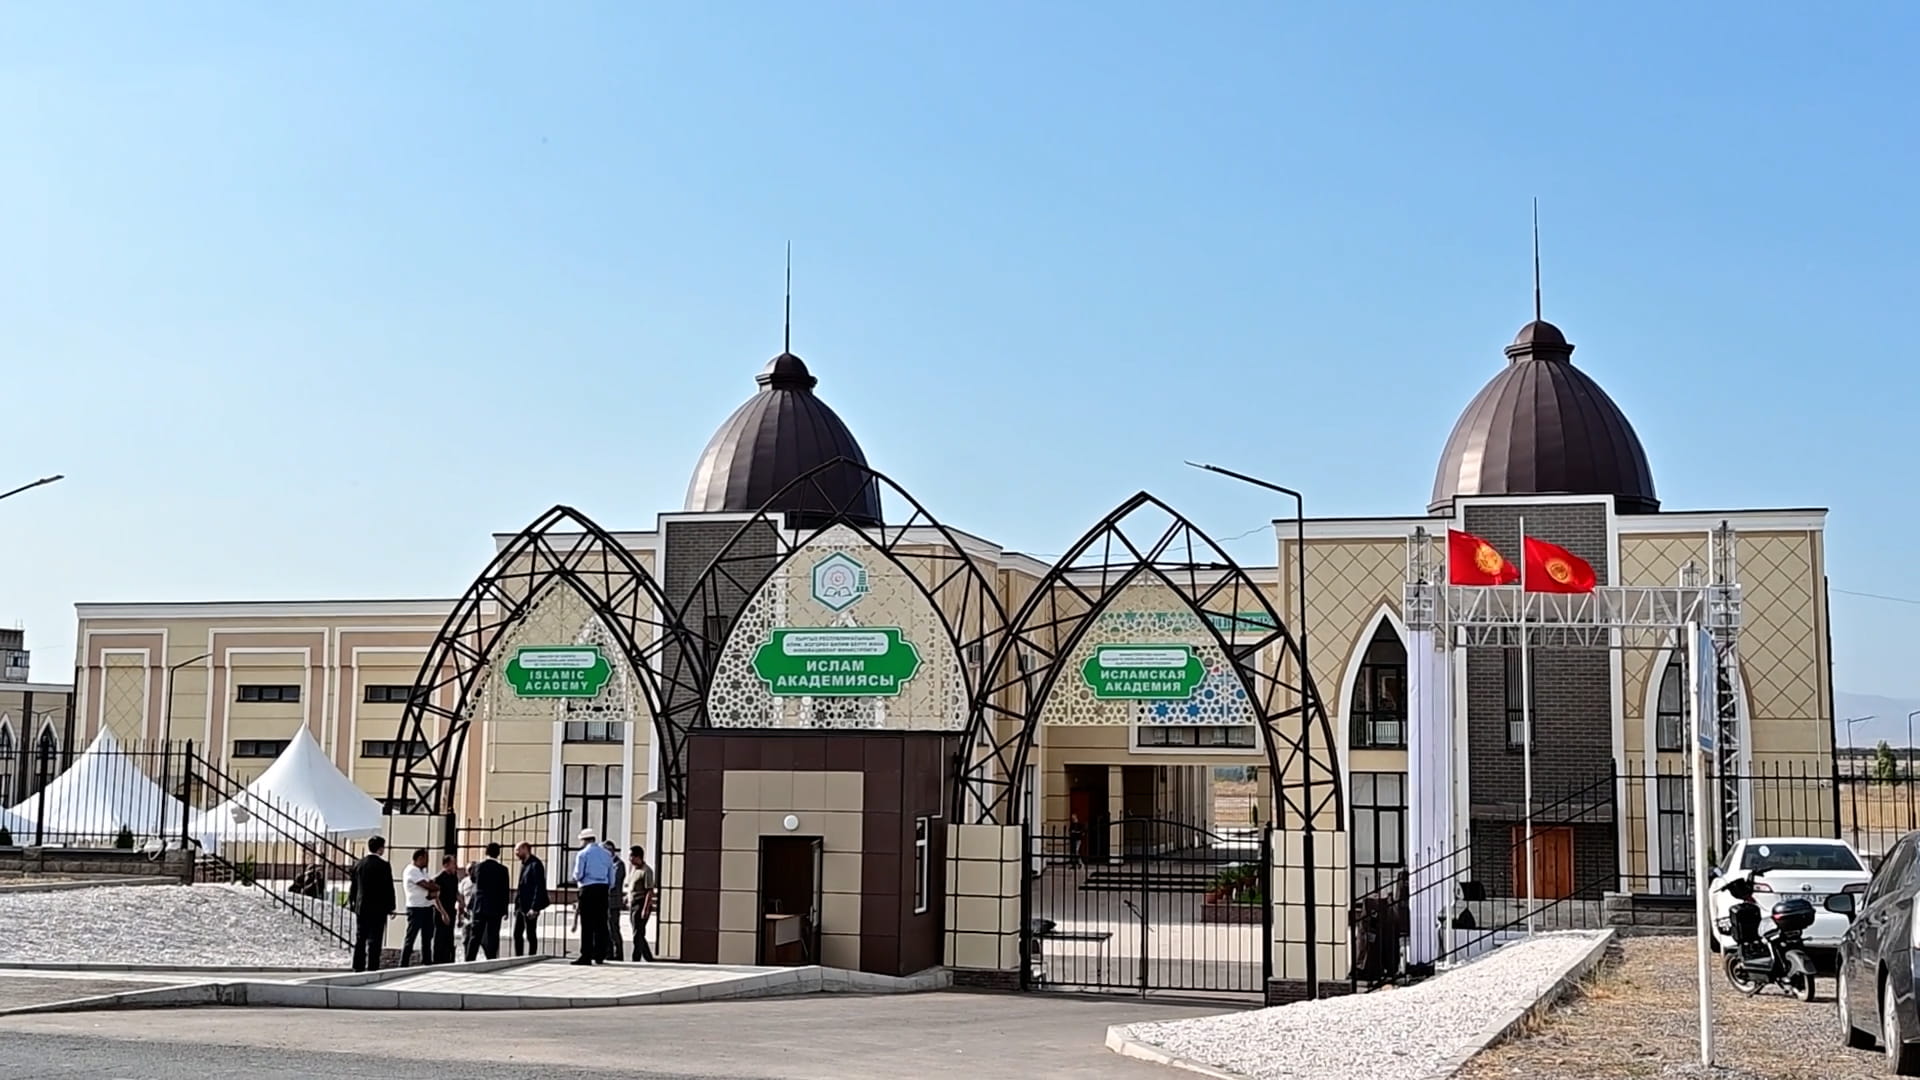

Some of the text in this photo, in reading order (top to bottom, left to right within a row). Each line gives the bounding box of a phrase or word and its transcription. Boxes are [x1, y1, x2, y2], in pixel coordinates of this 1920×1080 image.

[806, 660, 865, 672] ИСЛАМ
[529, 670, 585, 680] ISLAMIC
[1100, 669, 1186, 680] ИСЛАМСКАЯ
[524, 681, 589, 690] ACADEMY
[776, 675, 894, 688] АКАДЕМИЯСЫ
[1105, 682, 1181, 693] АКАДЕМИЯ
